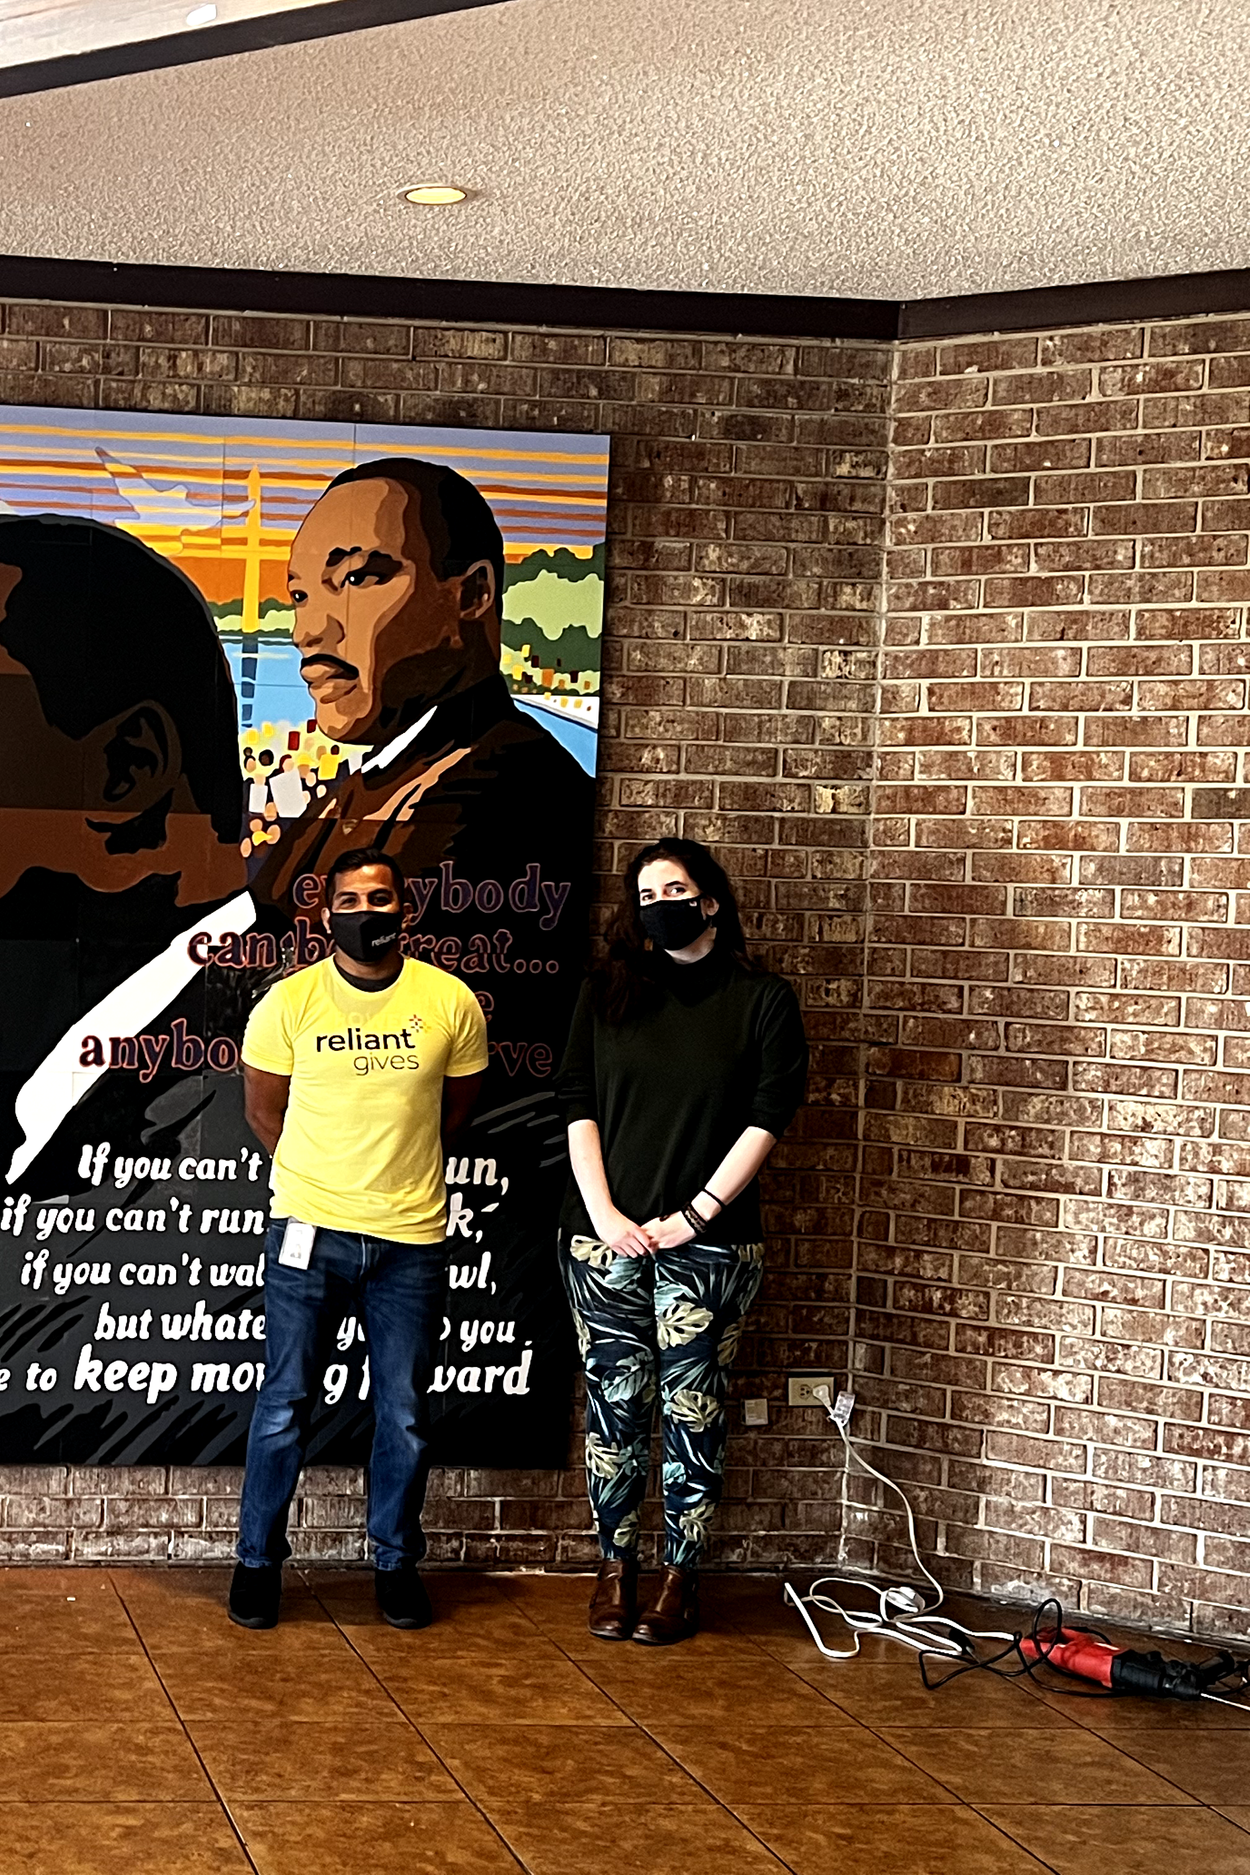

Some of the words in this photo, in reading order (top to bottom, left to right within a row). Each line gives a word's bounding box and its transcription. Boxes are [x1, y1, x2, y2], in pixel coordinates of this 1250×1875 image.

[293, 860, 572, 931] eybody
[187, 931, 278, 969] can
[398, 928, 560, 974] reat...
[78, 1018, 239, 1083] anybo
[315, 1027, 417, 1053] reliant
[353, 1051, 420, 1077] gives
[77, 1141, 111, 1187] If
[113, 1156, 172, 1189] you
[178, 1146, 263, 1182] can't
[444, 1156, 509, 1196] un,
[0, 1193, 33, 1237] if
[35, 1207, 95, 1241] you
[105, 1196, 193, 1233] can't
[199, 1208, 270, 1235] run
[20, 1248, 50, 1290] if
[52, 1262, 112, 1295] you
[119, 1252, 203, 1286] can't
[209, 1252, 266, 1287] wal
[93, 1301, 153, 1341] but
[160, 1299, 267, 1341] whate
[25, 1362, 57, 1391] to
[73, 1343, 178, 1405] keep
